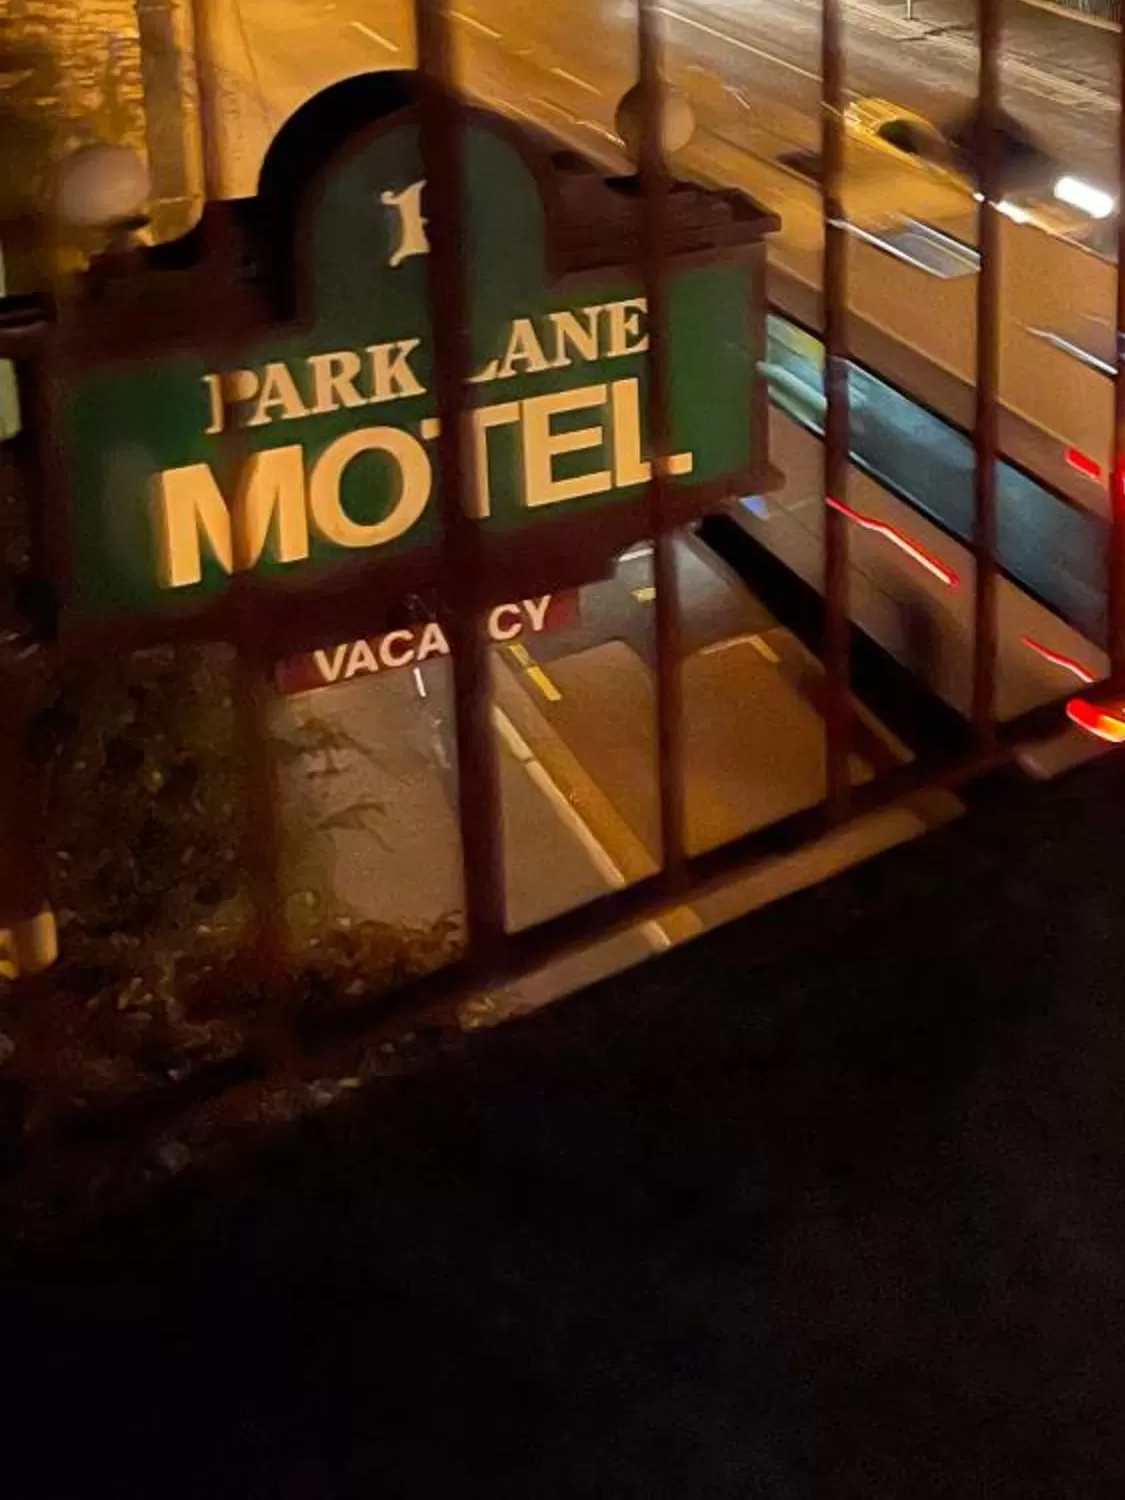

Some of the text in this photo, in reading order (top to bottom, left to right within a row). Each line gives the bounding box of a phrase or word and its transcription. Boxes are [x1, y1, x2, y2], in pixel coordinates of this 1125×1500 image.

[202, 337, 427, 434] PARK
[157, 377, 693, 588] MOTEL
[312, 595, 551, 682] VACACY
